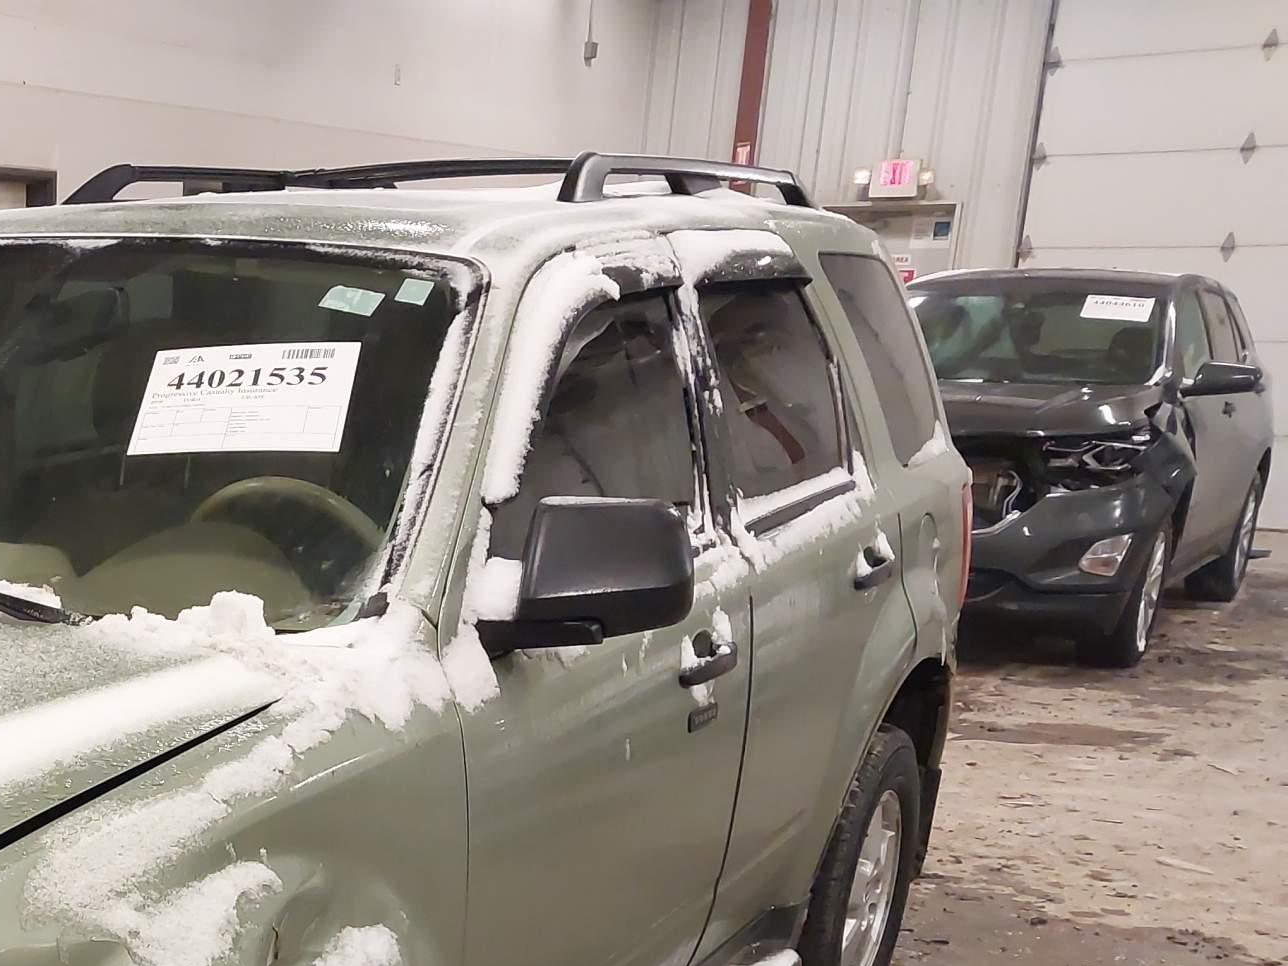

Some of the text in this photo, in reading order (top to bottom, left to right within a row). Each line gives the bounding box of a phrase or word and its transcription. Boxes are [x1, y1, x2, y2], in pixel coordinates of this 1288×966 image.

[880, 160, 914, 185] EXIT
[167, 366, 329, 390] 44021535
[152, 390, 199, 399] Progressive
